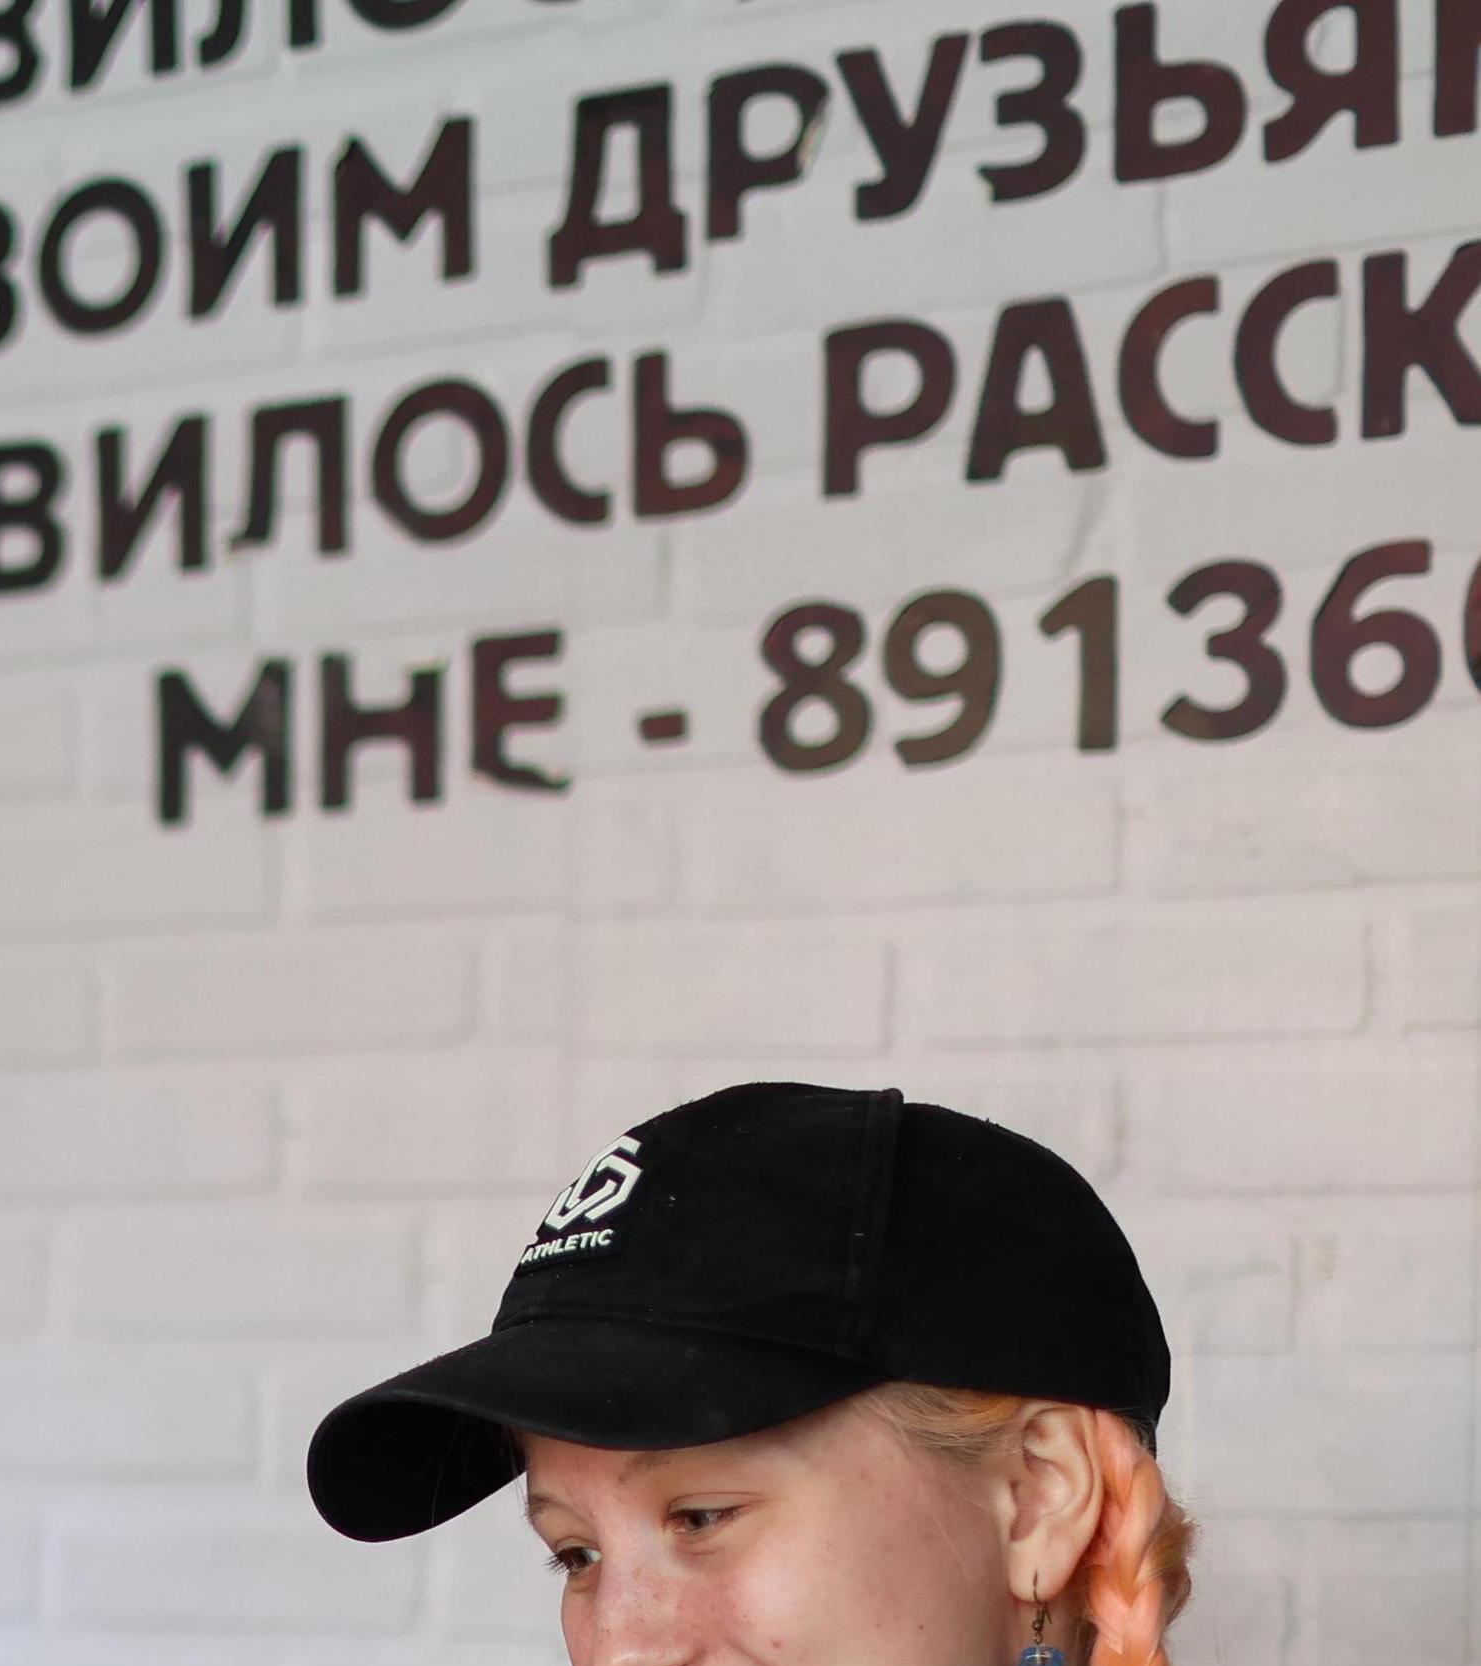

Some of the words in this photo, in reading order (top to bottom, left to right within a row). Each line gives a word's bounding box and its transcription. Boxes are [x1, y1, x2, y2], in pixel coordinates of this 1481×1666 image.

[156, 629, 569, 826] МНЕ
[758, 539, 1481, 773] 89136
[520, 1228, 614, 1265] ATHLETIC
